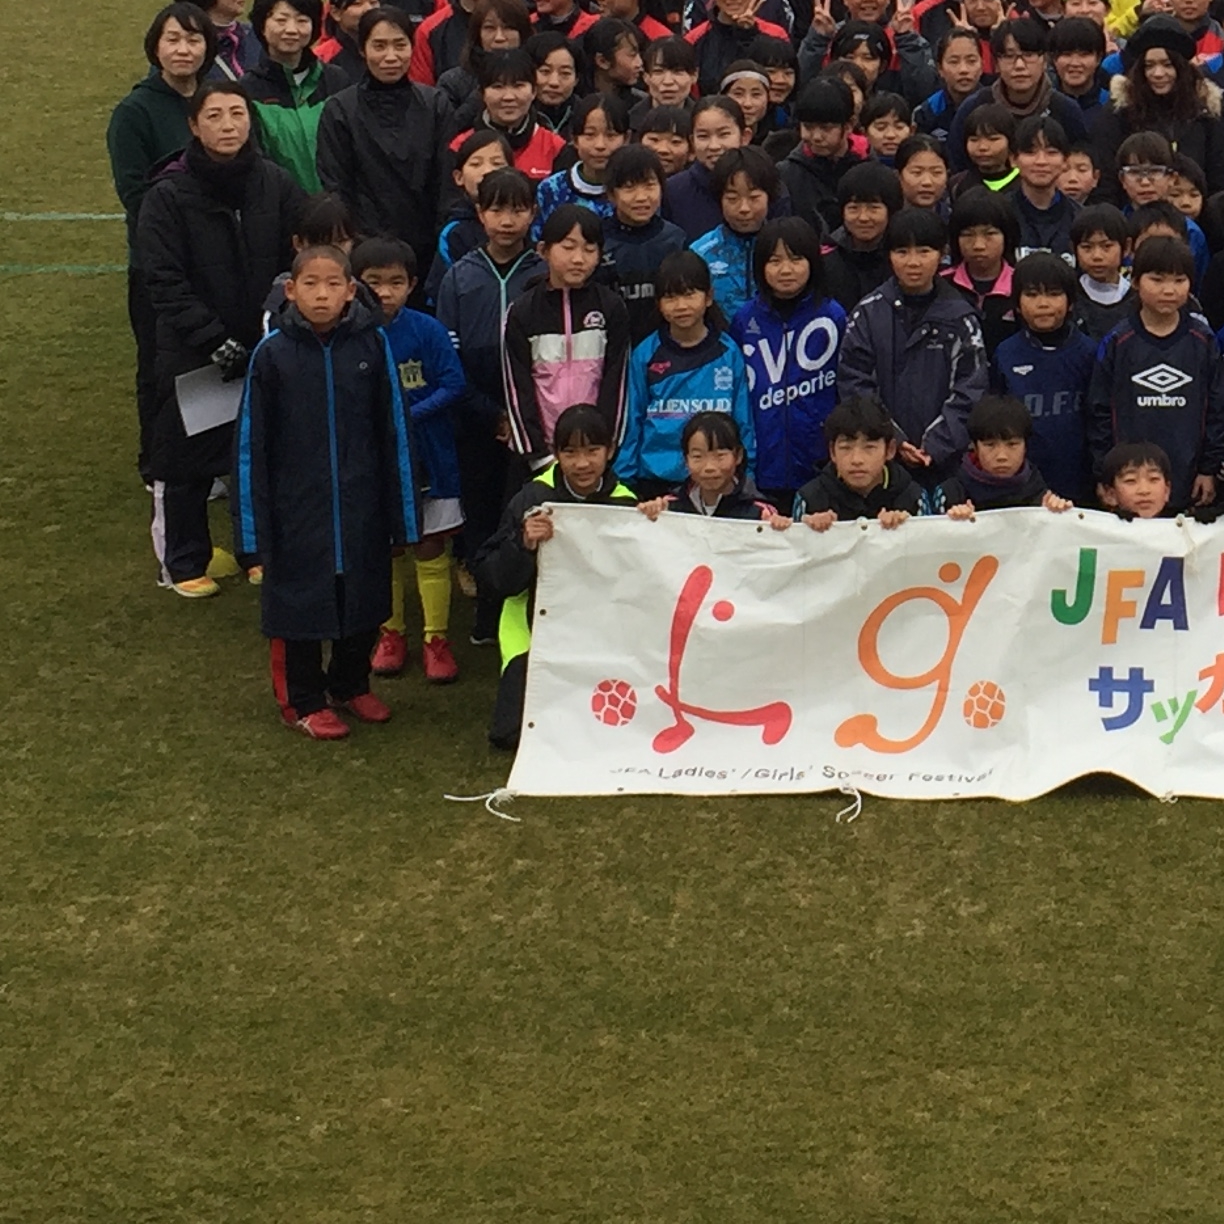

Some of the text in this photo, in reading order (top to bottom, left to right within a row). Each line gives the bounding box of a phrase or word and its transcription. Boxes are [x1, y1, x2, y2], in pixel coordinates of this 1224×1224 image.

[759, 370, 836, 410] deporte
[1137, 394, 1187, 407] umbro
[1050, 547, 1189, 644] JFA
